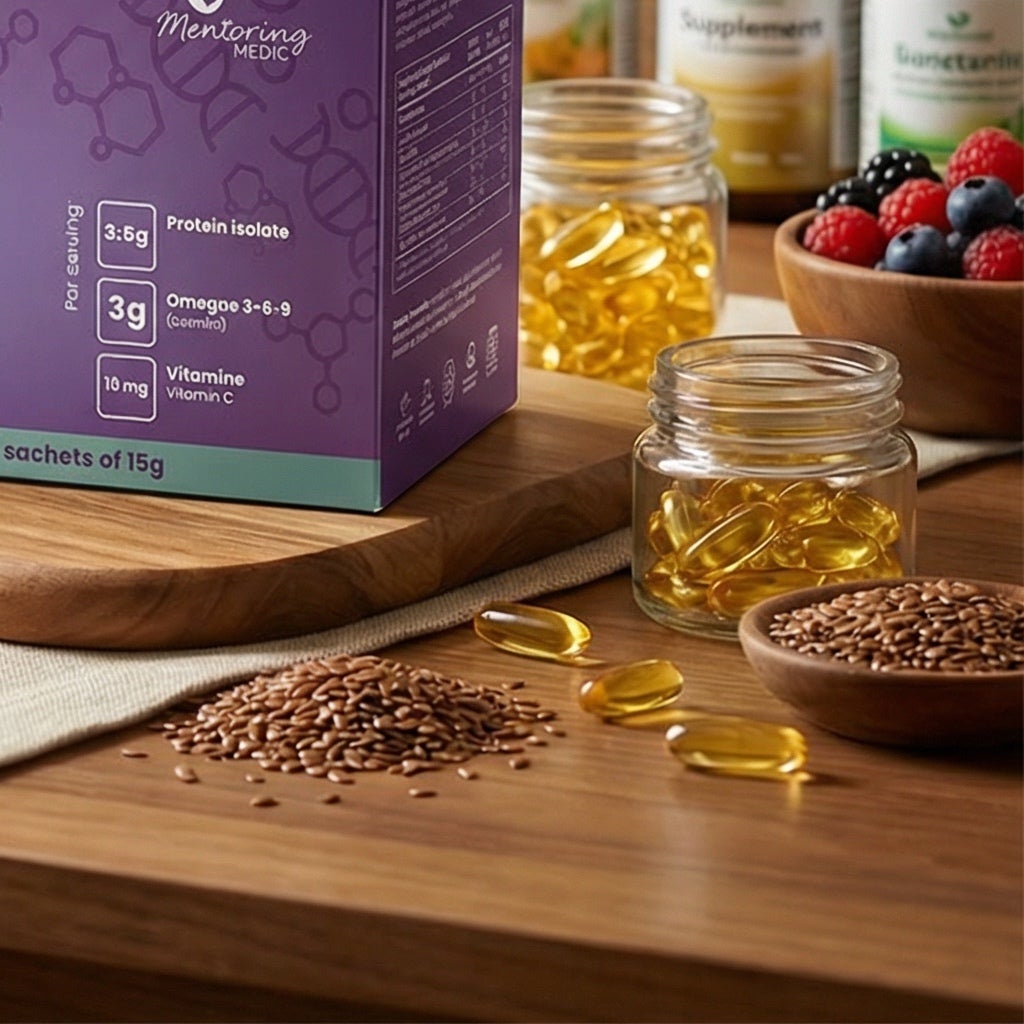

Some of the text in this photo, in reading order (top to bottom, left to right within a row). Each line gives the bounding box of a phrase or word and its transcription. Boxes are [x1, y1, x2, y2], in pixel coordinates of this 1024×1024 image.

[156, 10, 313, 56] Mentoring
[233, 43, 289, 62] MEDIC
[166, 215, 291, 241] Protein isolate
[107, 294, 147, 331] 3g
[166, 364, 246, 387] Vitamine
[122, 380, 149, 400] mg
[223, 391, 234, 405] C
[3, 443, 94, 468] sachets
[99, 449, 123, 470] of
[127, 451, 165, 480] 15g
